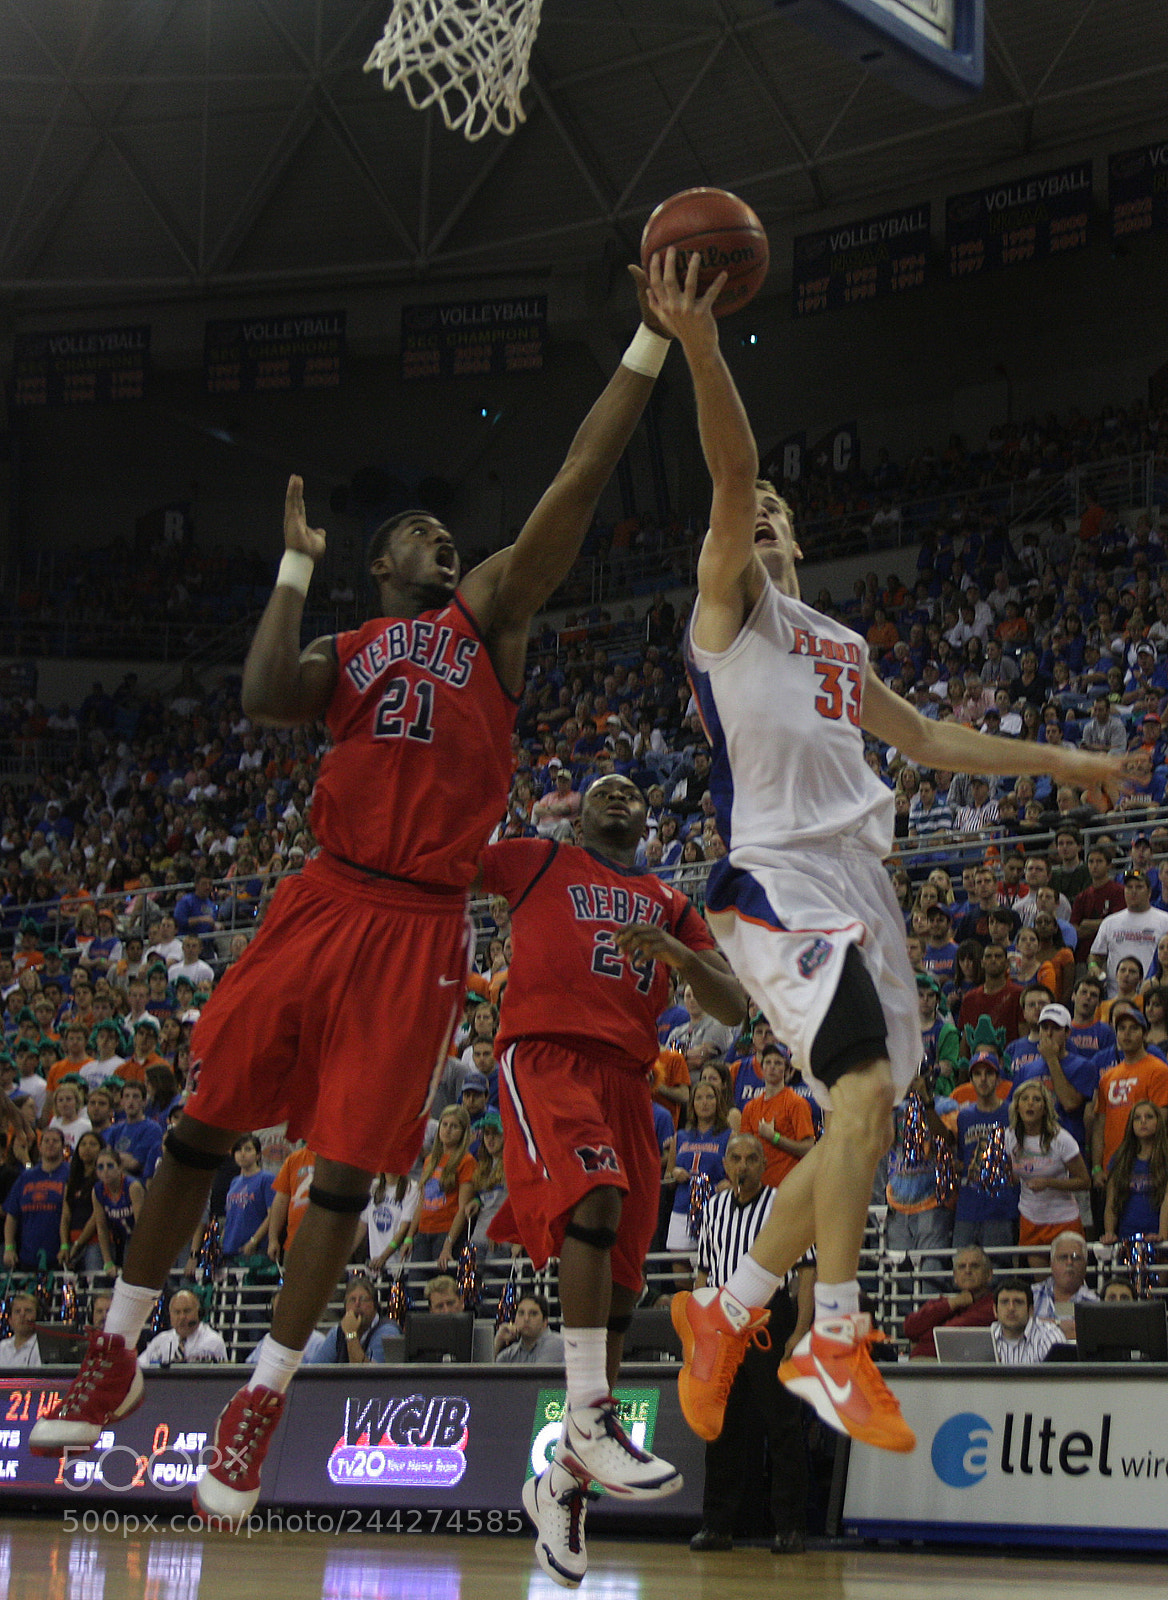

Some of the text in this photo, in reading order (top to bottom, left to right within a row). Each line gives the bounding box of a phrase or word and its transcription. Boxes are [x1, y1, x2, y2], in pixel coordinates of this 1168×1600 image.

[985, 170, 1090, 213] VOLLEYBALL
[829, 211, 928, 252] VOLLEYBALL
[243, 317, 342, 341] VOLLEYBALL
[440, 300, 543, 326] VOLLEYBALL
[49, 332, 145, 355] VOLLEYBALL
[833, 431, 852, 472] C
[345, 620, 480, 694] REBELS
[373, 676, 435, 744] 21
[814, 661, 861, 728] 33
[591, 929, 657, 996] 24
[5, 1390, 32, 1421] 21
[345, 1394, 470, 1446] WCJB
[172, 1432, 208, 1451] AST
[962, 1412, 1112, 1476] alltel
[131, 1455, 149, 1487] 2
